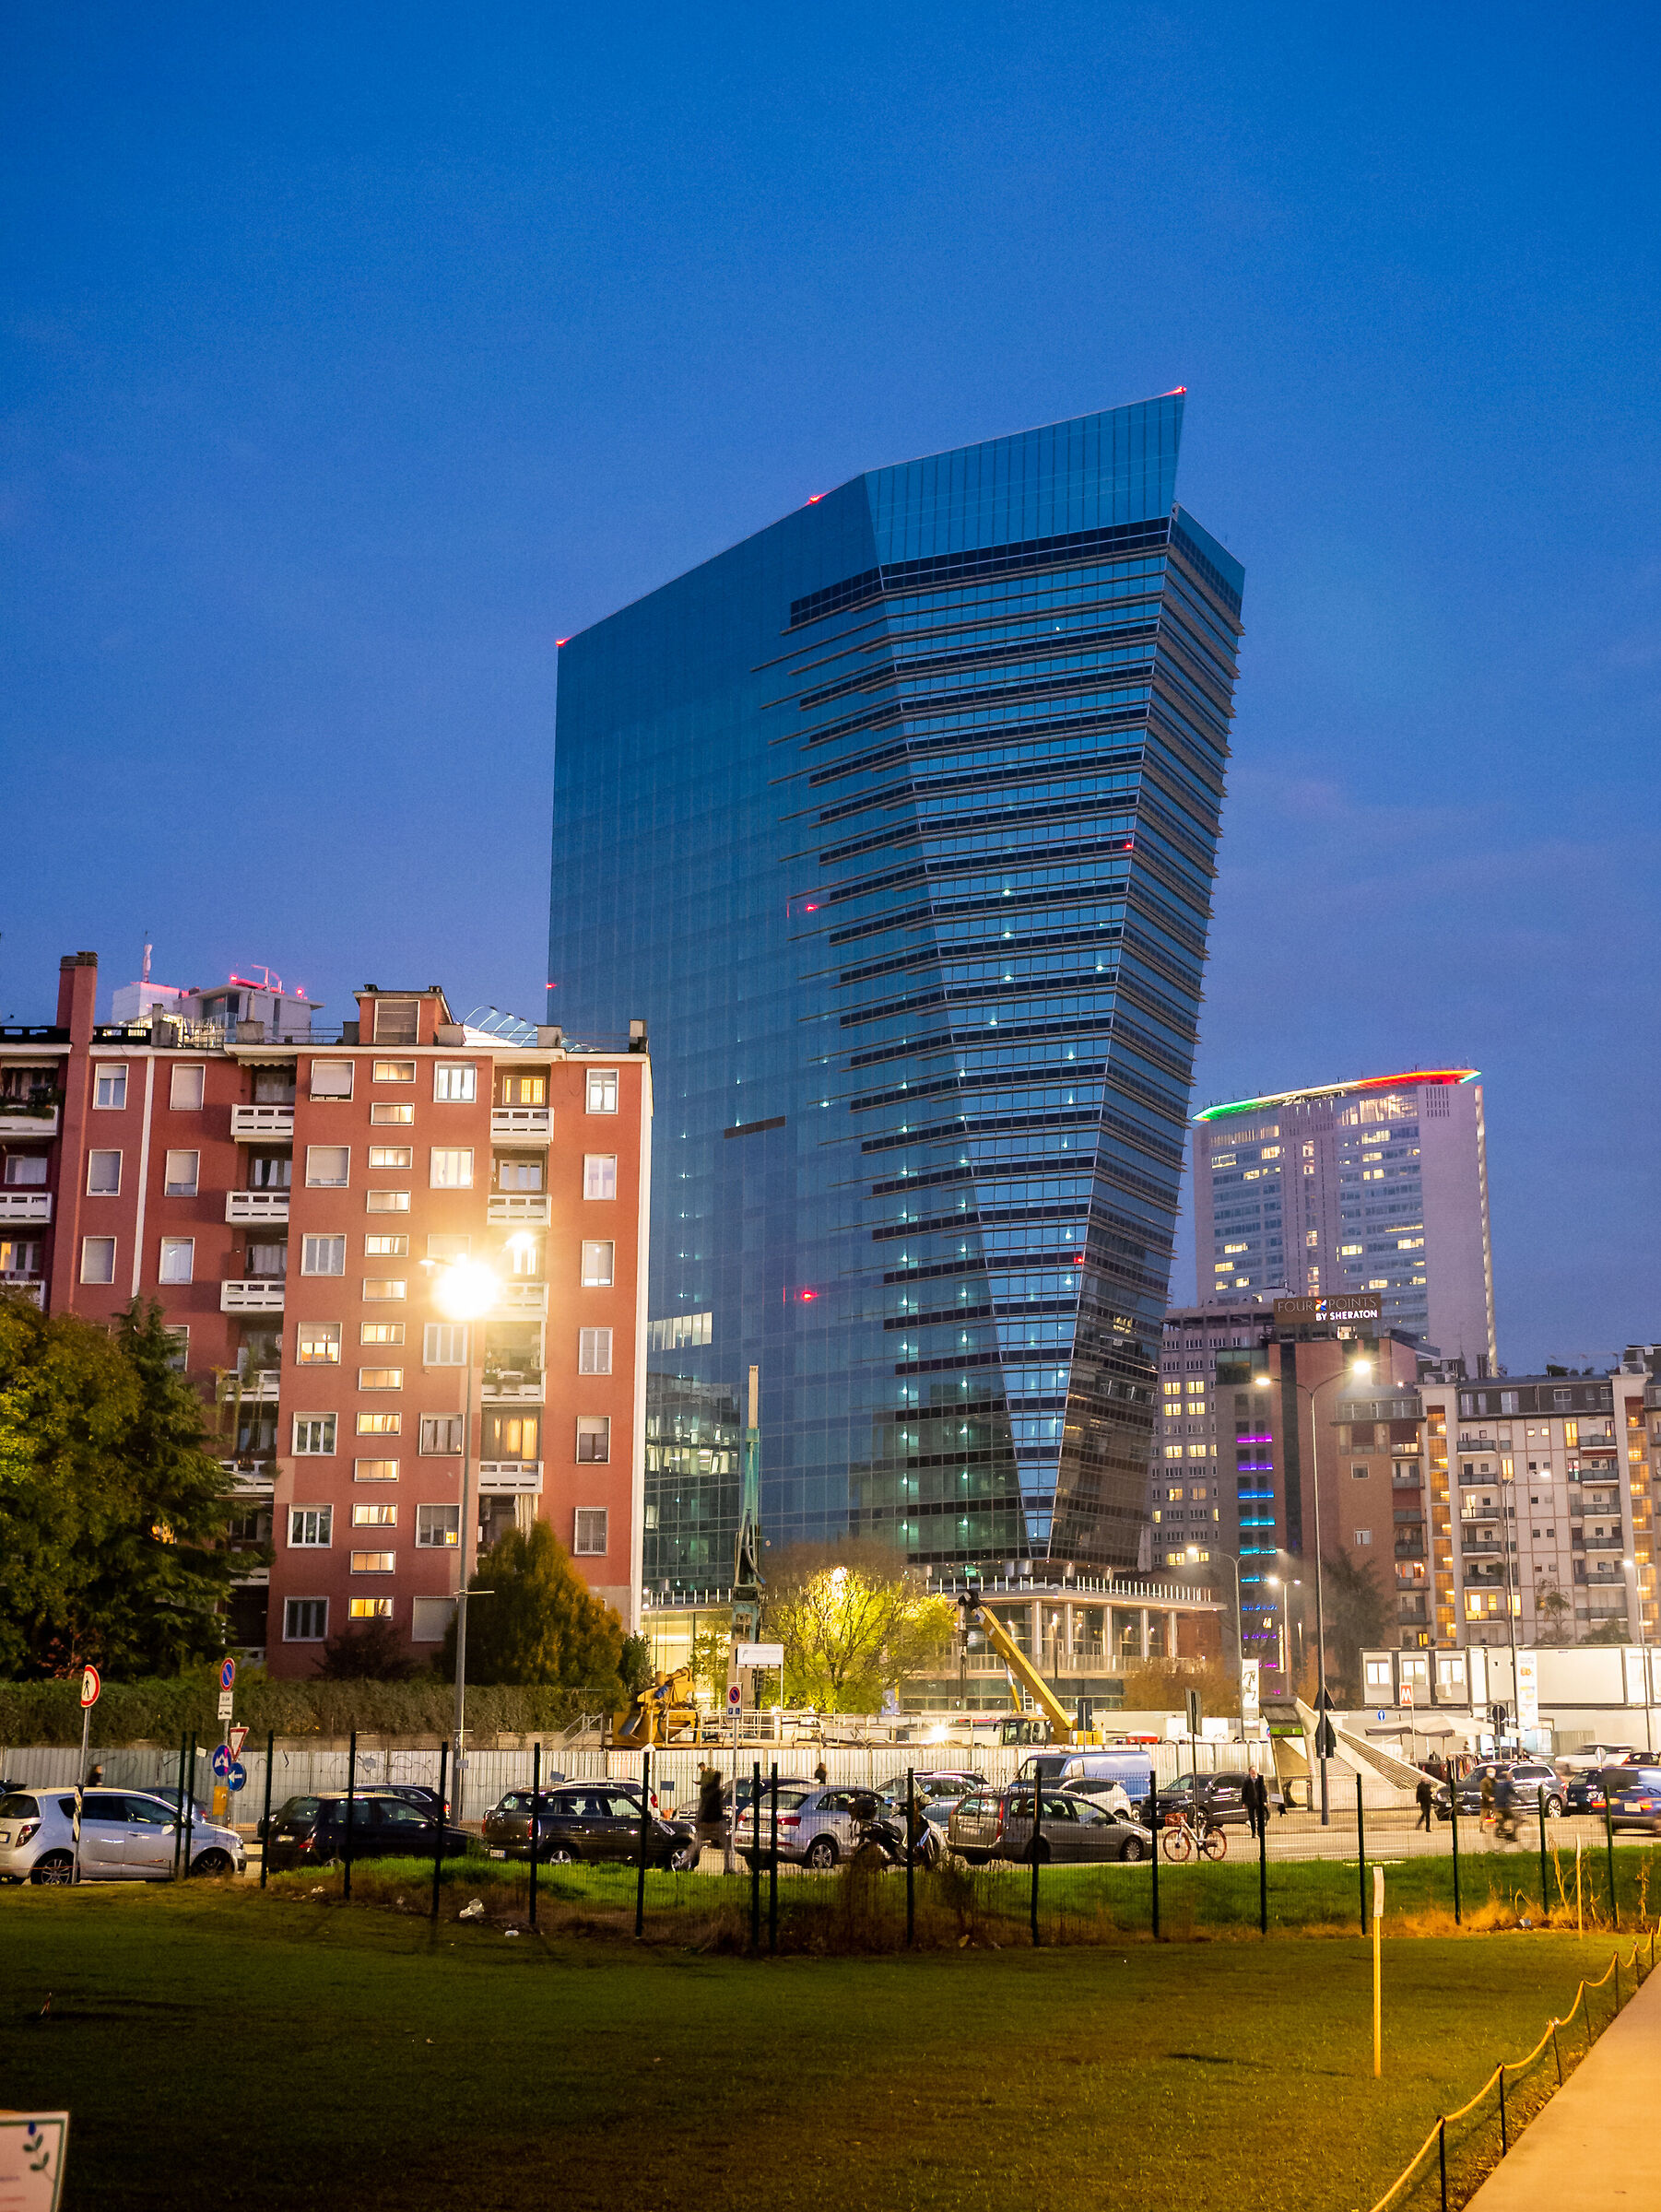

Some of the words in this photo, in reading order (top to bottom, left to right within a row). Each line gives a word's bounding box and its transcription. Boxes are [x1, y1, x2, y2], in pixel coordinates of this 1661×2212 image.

[1278, 1300, 1313, 1312] FOUR
[1328, 1297, 1376, 1309] POINTS
[1315, 1312, 1327, 1322] BY
[1329, 1310, 1378, 1321] SHERATON
[1401, 1688, 1412, 1702] M
